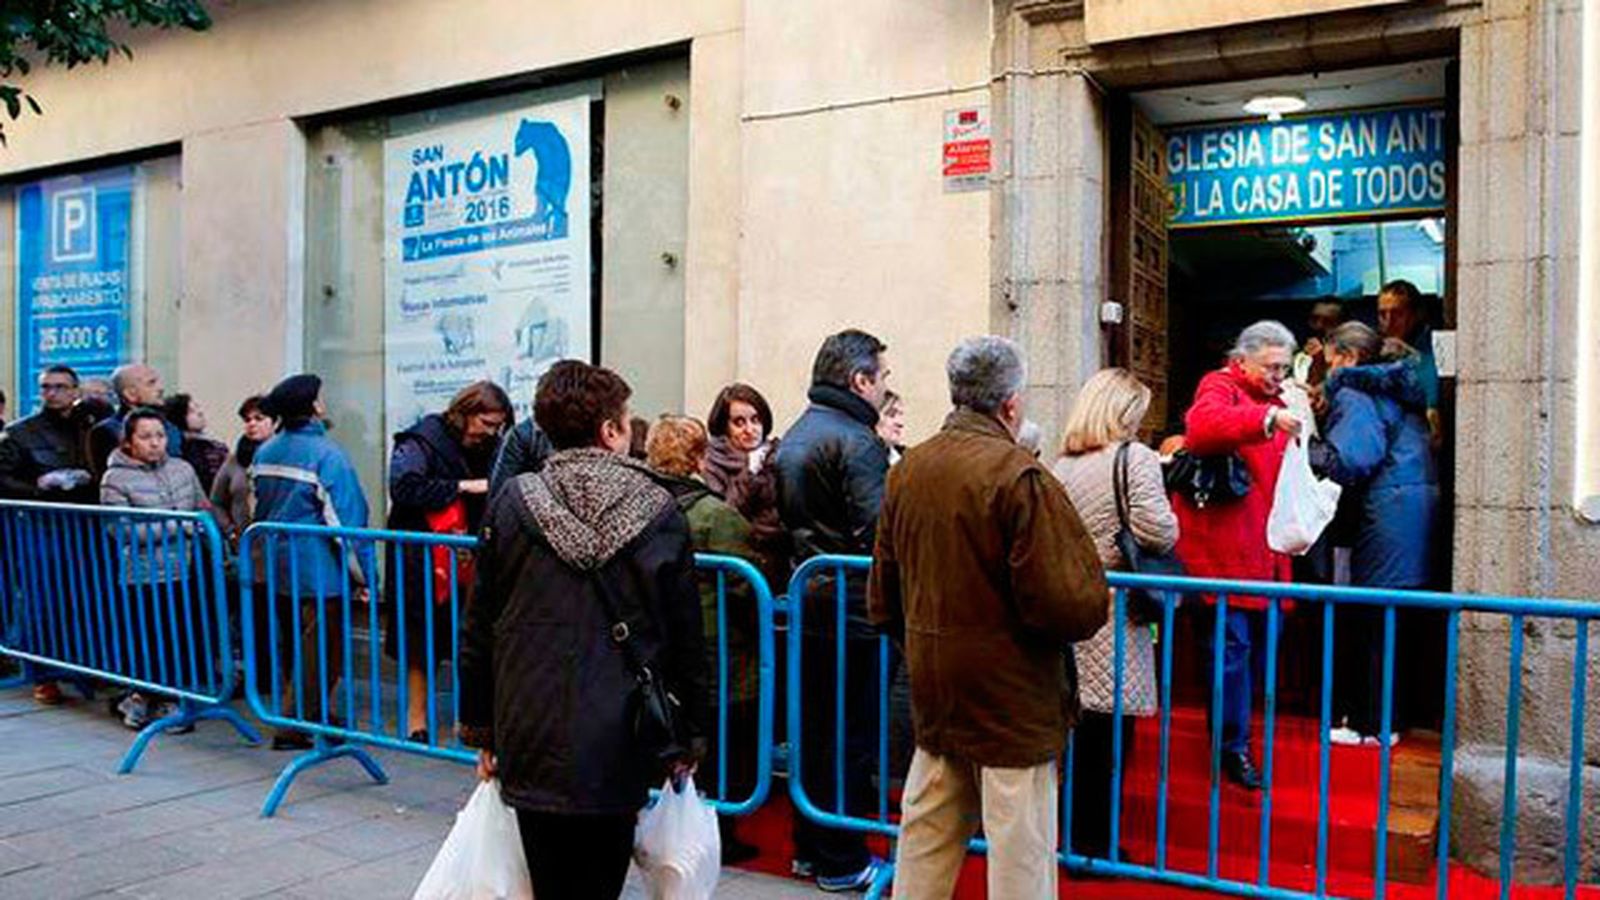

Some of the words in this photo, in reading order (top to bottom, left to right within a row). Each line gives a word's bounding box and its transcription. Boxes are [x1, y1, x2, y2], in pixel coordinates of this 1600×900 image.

[411, 145, 443, 167] SAN
[1167, 130, 1264, 174] GLESIA
[1271, 125, 1310, 165] DE
[1317, 118, 1377, 161] SAN
[1385, 110, 1446, 155] ANT
[405, 150, 509, 204] ANTÓN
[1194, 178, 1226, 216] LA
[1232, 173, 1302, 214] CASA
[1308, 169, 1343, 208] DE
[1352, 160, 1446, 205] TODOS
[64, 198, 86, 251] P
[465, 196, 510, 223] 2016
